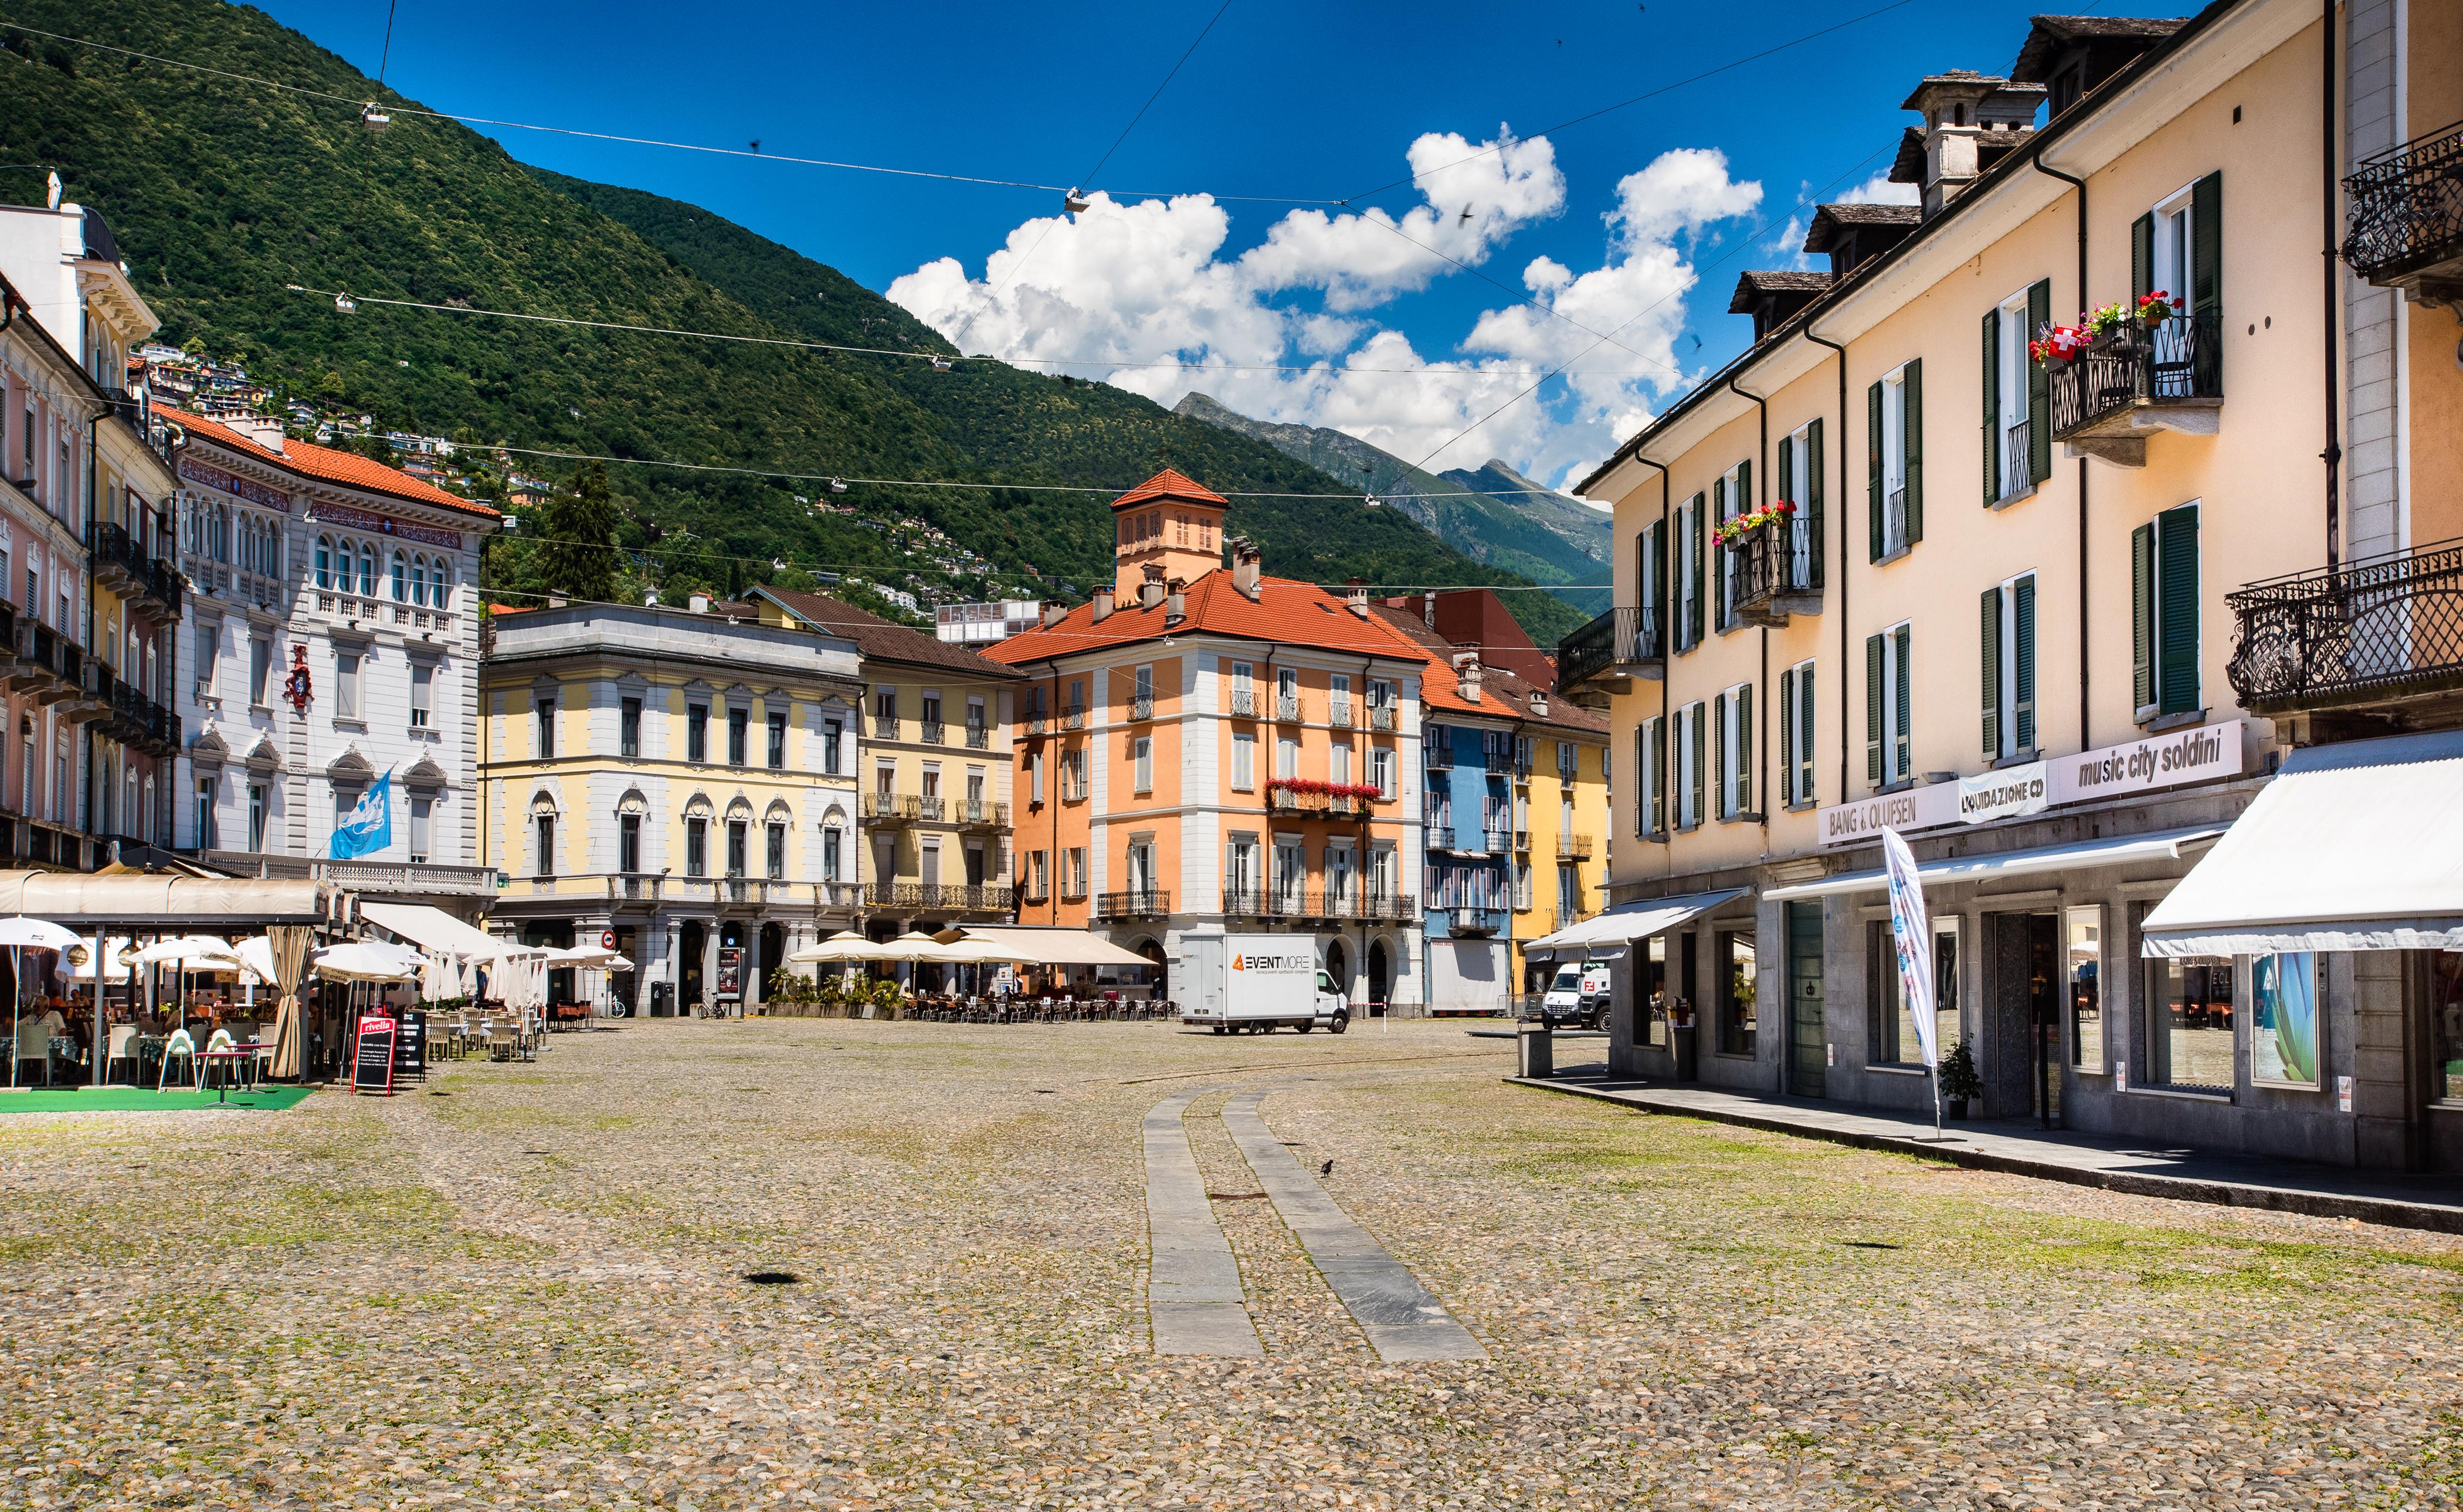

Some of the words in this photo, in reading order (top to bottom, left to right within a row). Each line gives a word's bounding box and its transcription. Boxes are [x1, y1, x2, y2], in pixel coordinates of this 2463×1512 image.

[2078, 750, 2124, 787] music
[2128, 745, 2158, 783] city
[2161, 728, 2221, 772] soldini
[1962, 782, 2027, 814] LIQUIDAZIONE
[2030, 779, 2044, 798] CD
[1829, 809, 1857, 837] BANG
[1861, 807, 1867, 831] &
[1869, 796, 1916, 830] OLUFSEN
[1246, 956, 1309, 969] EVENTMORE
[365, 1021, 390, 1031] rivella
